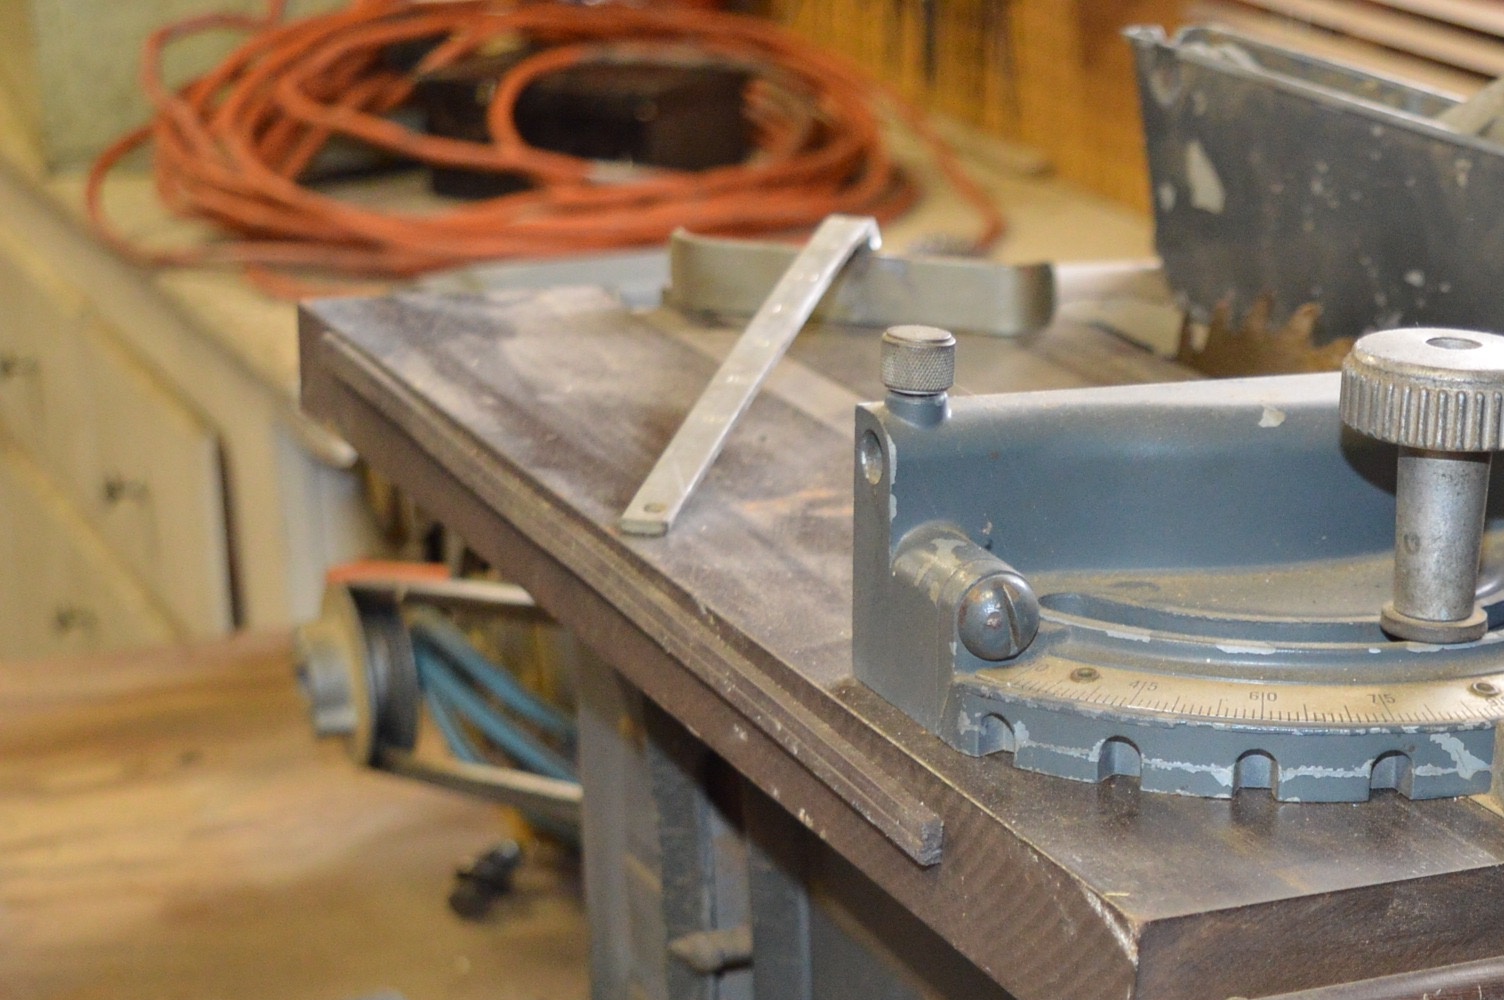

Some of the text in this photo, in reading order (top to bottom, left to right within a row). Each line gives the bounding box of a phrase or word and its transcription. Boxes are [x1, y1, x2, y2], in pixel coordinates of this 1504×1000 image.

[1128, 680, 1159, 692] 45
[1249, 691, 1278, 702] 60
[1366, 693, 1396, 705] 75
